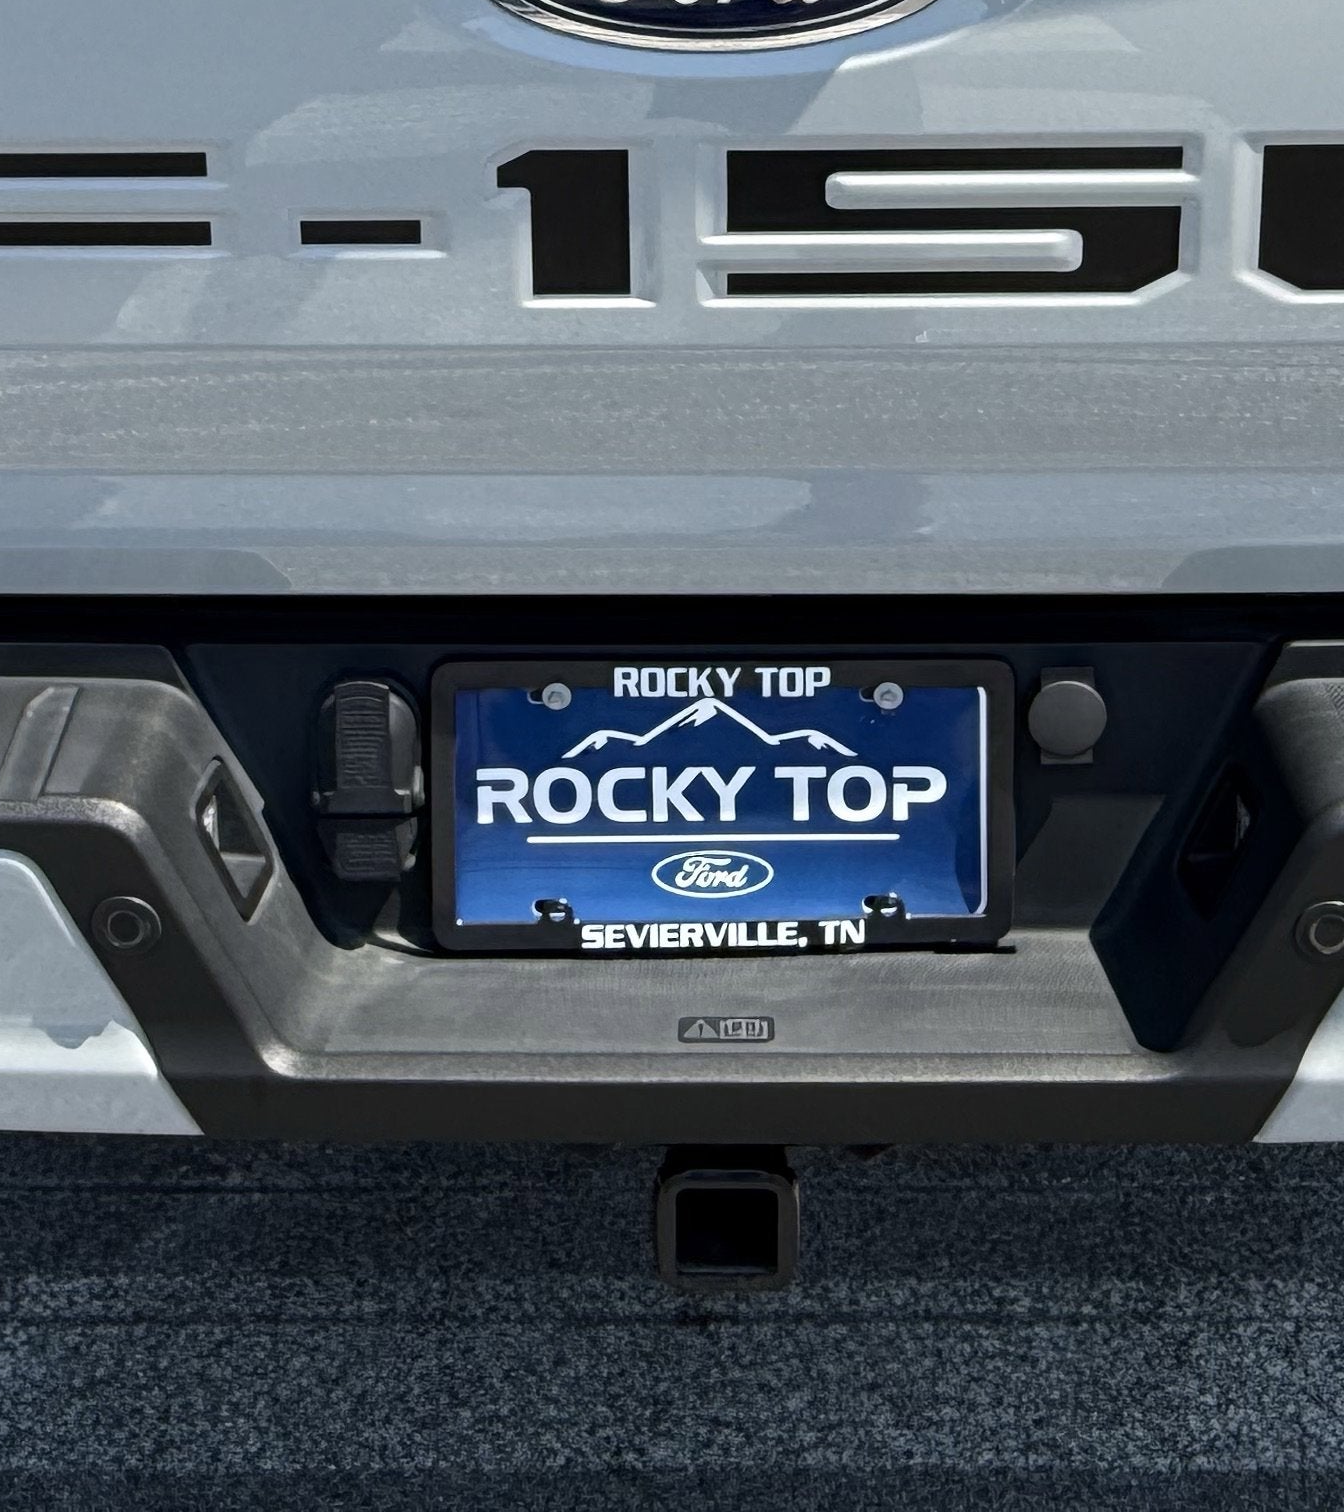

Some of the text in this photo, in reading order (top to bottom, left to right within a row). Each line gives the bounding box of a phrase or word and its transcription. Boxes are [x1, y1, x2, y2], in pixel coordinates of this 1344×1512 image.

[613, 666, 831, 698] ROCKY TOP
[475, 765, 948, 825] ROCKY TOP
[675, 856, 749, 888] Ford
[581, 918, 865, 949] SEVIERVILLE, TN
